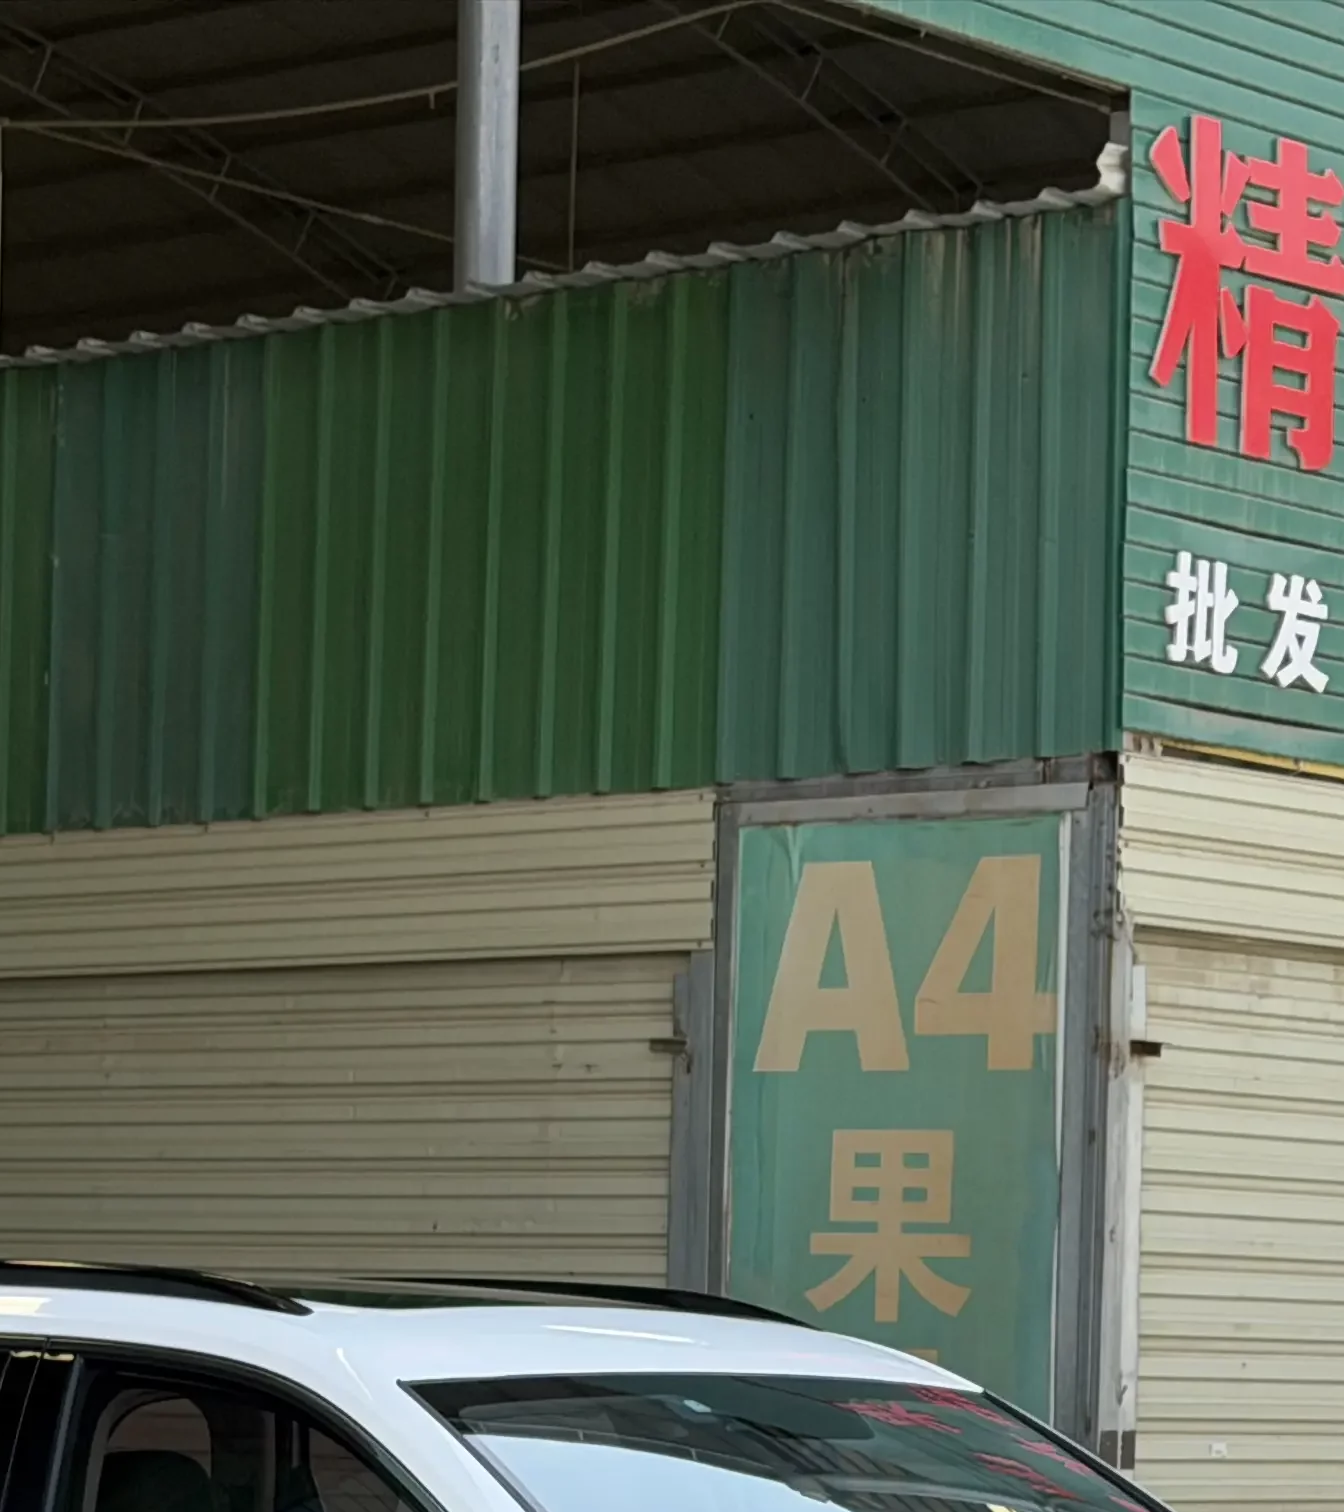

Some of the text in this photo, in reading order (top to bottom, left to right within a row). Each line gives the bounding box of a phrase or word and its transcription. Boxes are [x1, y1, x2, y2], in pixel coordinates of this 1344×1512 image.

[1165, 551, 1329, 693] 批发
[753, 854, 1056, 1073] A4
[804, 1130, 972, 1364] 果
